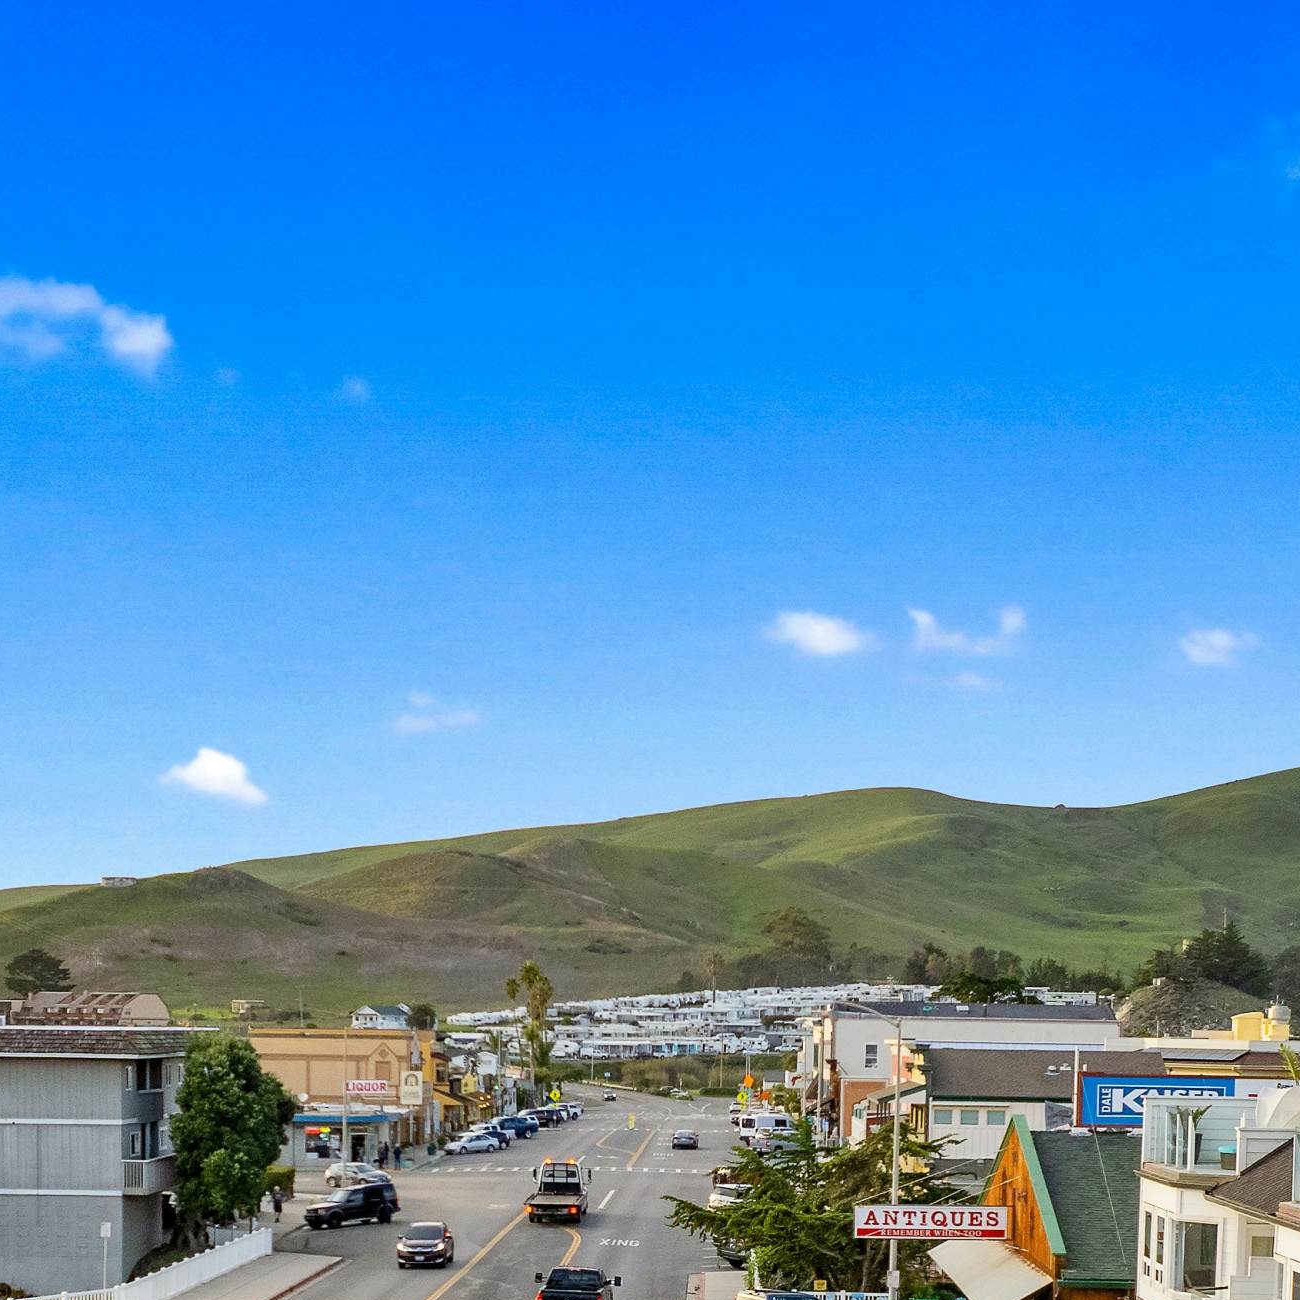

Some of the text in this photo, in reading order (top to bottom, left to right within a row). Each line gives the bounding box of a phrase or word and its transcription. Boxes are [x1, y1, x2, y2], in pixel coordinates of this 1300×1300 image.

[345, 1081, 387, 1092] LIQUOR
[1101, 1088, 1111, 1112] DALE
[863, 1210, 999, 1227] ANTIQUES
[880, 1229, 931, 1237] REMEMBER
[933, 1229, 962, 1237] WHEN
[599, 1238, 640, 1247] XING
